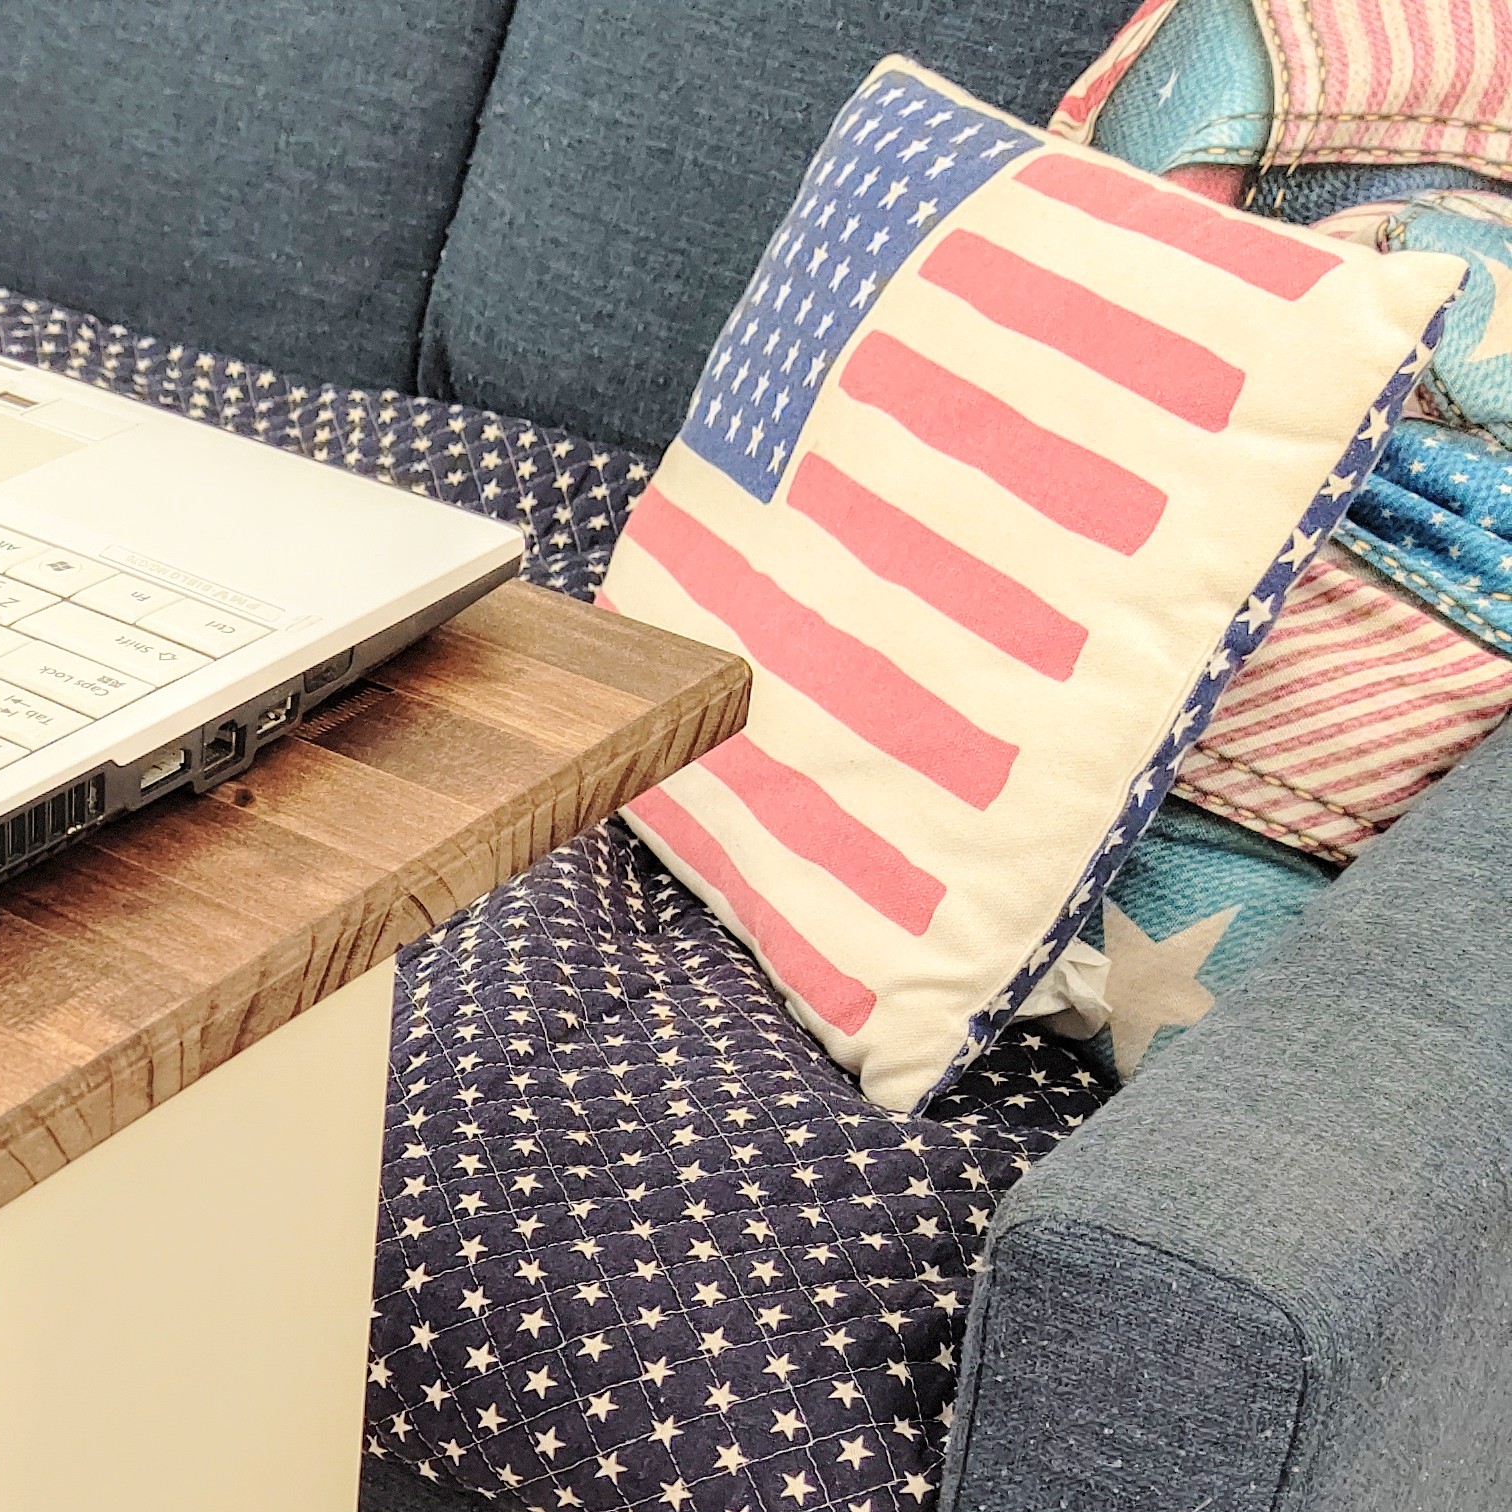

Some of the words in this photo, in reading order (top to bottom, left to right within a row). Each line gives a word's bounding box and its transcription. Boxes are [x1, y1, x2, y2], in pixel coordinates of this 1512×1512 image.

[130, 591, 152, 602] Fn
[204, 620, 236, 634] Ctrl
[114, 635, 155, 654] Shift
[38, 665, 75, 683] Lock
[74, 676, 111, 697] Caps
[24, 710, 54, 726] Tab
